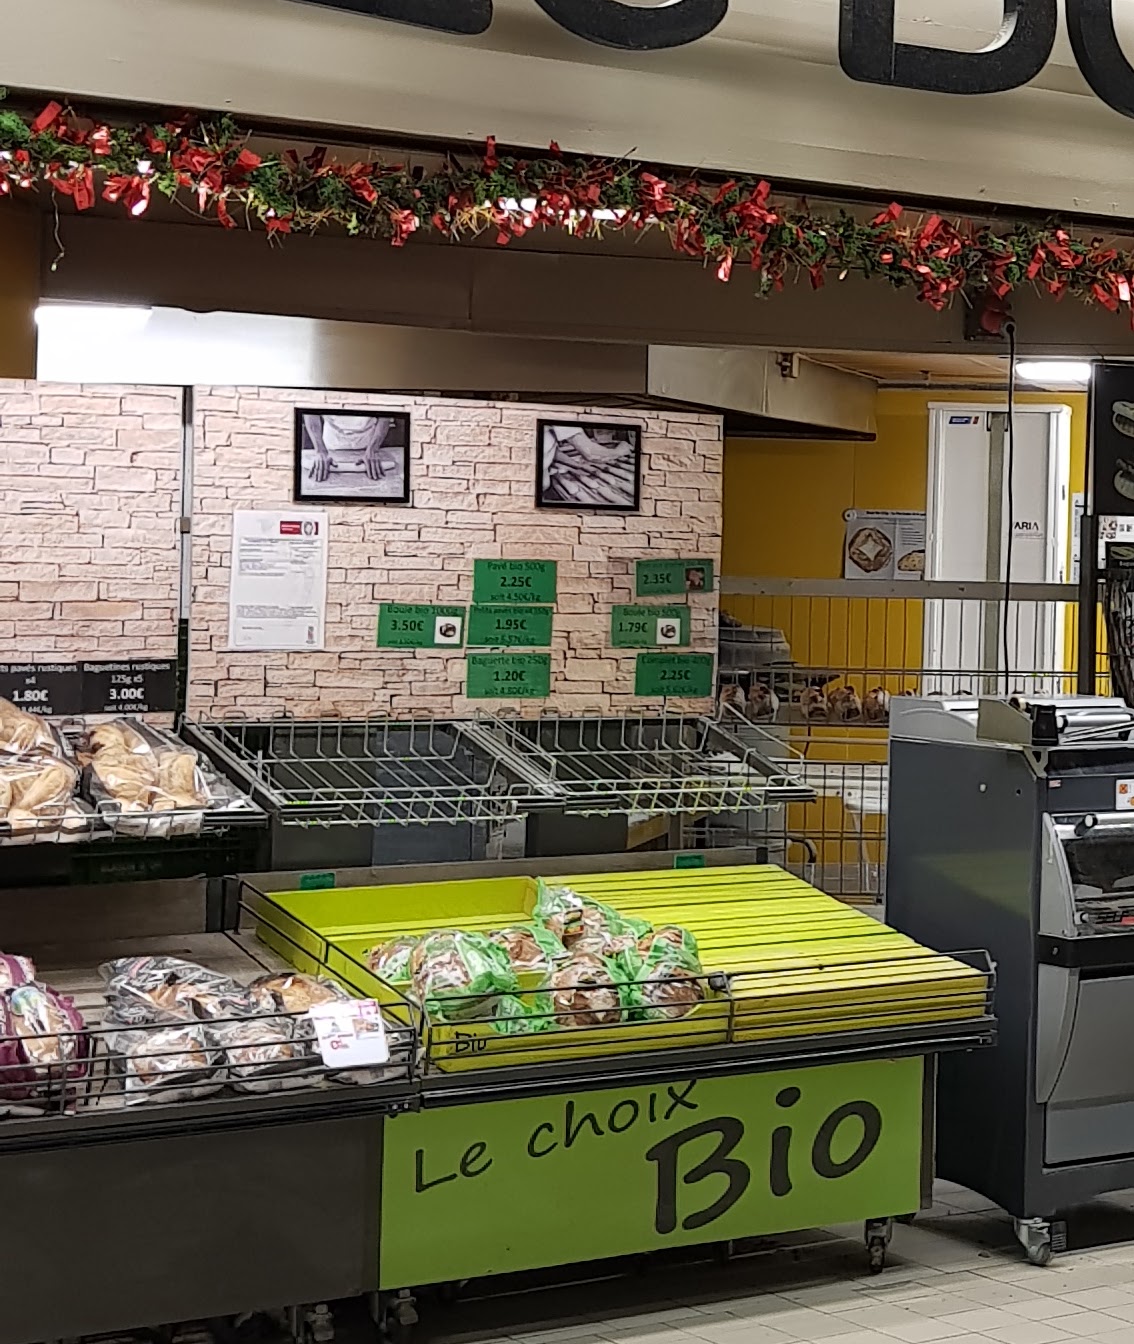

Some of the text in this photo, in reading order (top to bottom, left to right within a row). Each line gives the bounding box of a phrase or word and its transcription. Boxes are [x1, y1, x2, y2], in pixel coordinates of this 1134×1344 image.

[488, 561, 545, 573] Pavé bio 500g
[500, 576, 532, 588] 2.25€
[643, 573, 672, 585] 2.35€
[387, 606, 413, 614] Boule
[415, 606, 429, 615] bio
[648, 608, 660, 616] bio
[391, 620, 425, 632] 3.50€
[495, 619, 527, 630] 1.95€
[619, 622, 648, 633] 1.79€
[132, 662, 171, 672] rustiques
[472, 656, 548, 667] Baguette bio 250g
[11, 664, 78, 673] pavés rustiques
[493, 671, 527, 682] 1.20€
[660, 670, 691, 681] 2.25€
[13, 690, 49, 702] 1.80€
[110, 688, 145, 700] 3.00€
[455, 1031, 487, 1053] Bio
[415, 1079, 698, 1193] Le choix
[646, 1086, 883, 1235] Bio
